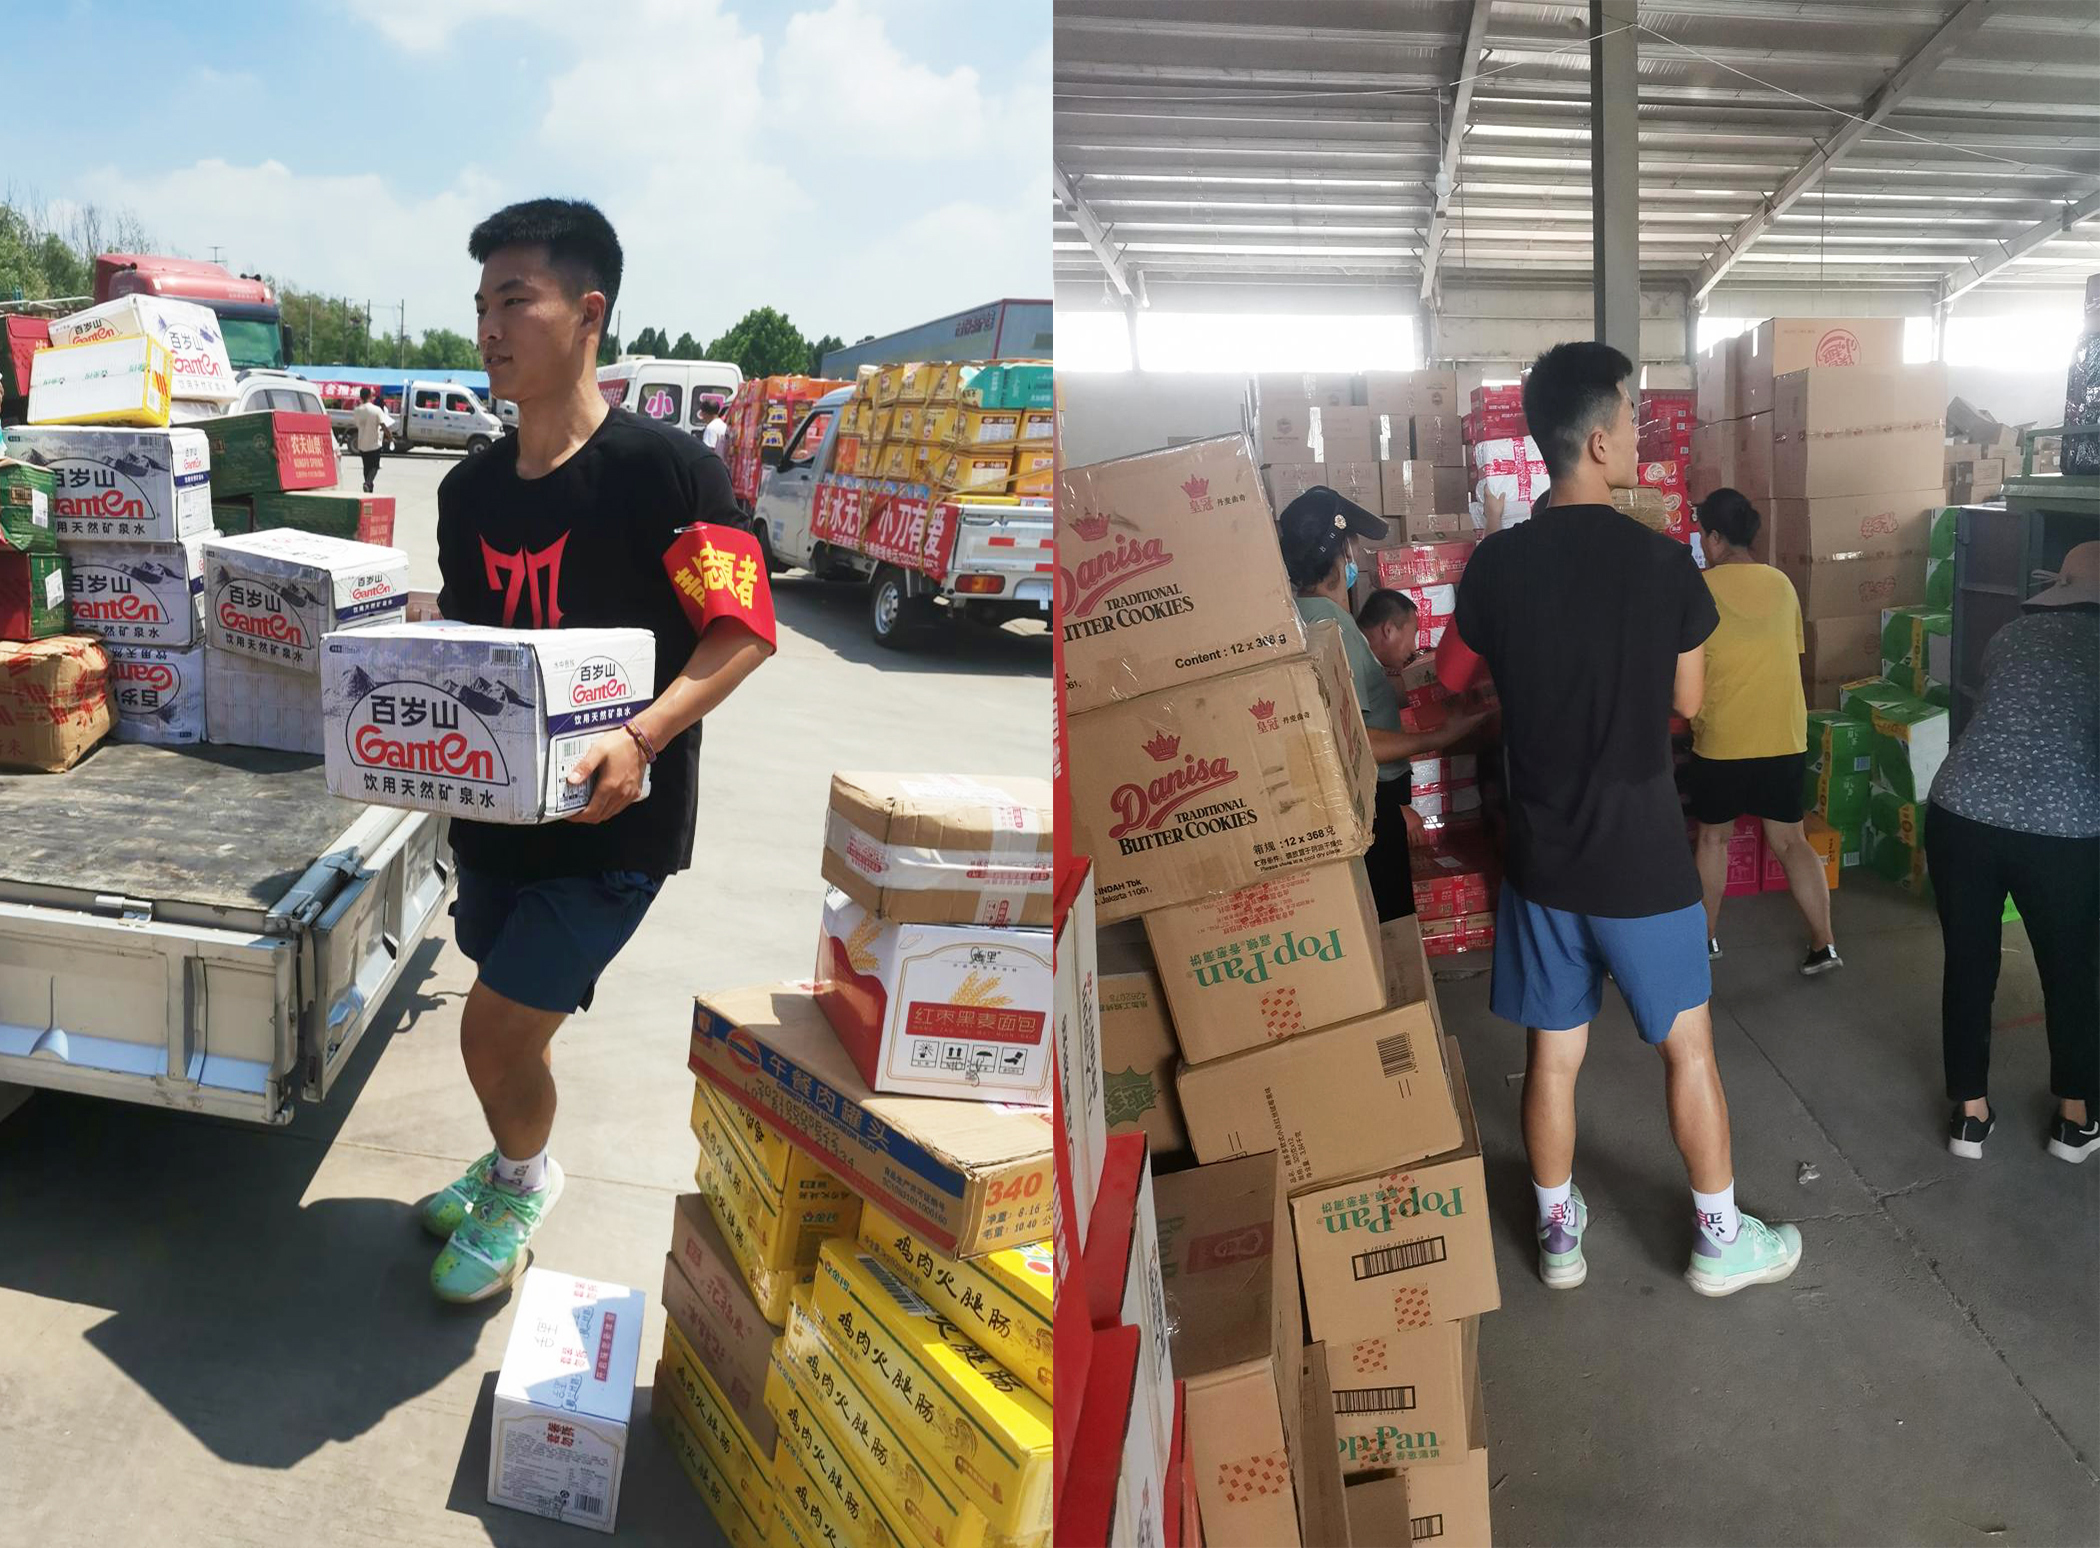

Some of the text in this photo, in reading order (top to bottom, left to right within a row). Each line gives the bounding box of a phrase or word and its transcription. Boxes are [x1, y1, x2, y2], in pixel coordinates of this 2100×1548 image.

[74, 318, 103, 335] 百岁山
[170, 331, 204, 351] 百岁山
[645, 390, 675, 419] 小
[57, 521, 147, 537] 用天然矿泉水
[358, 573, 384, 588] 百岁山
[228, 584, 282, 614] 百岁山
[1104, 583, 1183, 612] TRADITIONAL
[1115, 595, 1195, 629] COOKIES
[224, 632, 305, 663] 饮用天然矿泉水
[1174, 649, 1222, 669] Content
[1230, 643, 1246, 656] 12
[1278, 633, 1288, 645] g
[579, 662, 617, 683] 百岁山
[115, 687, 160, 709] 百岁
[370, 693, 460, 731] 百岁山
[573, 705, 633, 726] 饮用天然矿泉水
[1256, 716, 1281, 736] 皇冠
[355, 723, 495, 781] Ganten
[363, 772, 497, 809] 饮用天然矿泉水
[1108, 752, 1240, 840] Danisa
[1174, 797, 1248, 825] TRADITIONAL
[1117, 808, 1259, 858] BUTTER COOKIES
[1306, 828, 1325, 842] 368
[1098, 878, 1143, 897] INDAH Tbk
[1192, 928, 1348, 988] Pop-Pan
[914, 1006, 1037, 1034] 红枣黑麦面包
[985, 1171, 1044, 1208] 340
[1017, 1203, 1041, 1219] 8.16
[1014, 1219, 1038, 1234] 10.40
[893, 1235, 1012, 1339] 鸡肉火腿肠
[837, 1311, 936, 1425] 鸡肉火腿肠
[806, 1353, 888, 1467] 鸡肉火腿肠
[787, 1407, 860, 1521] 鸡肉火腿肠
[795, 1485, 845, 1548] 鸡肉火
